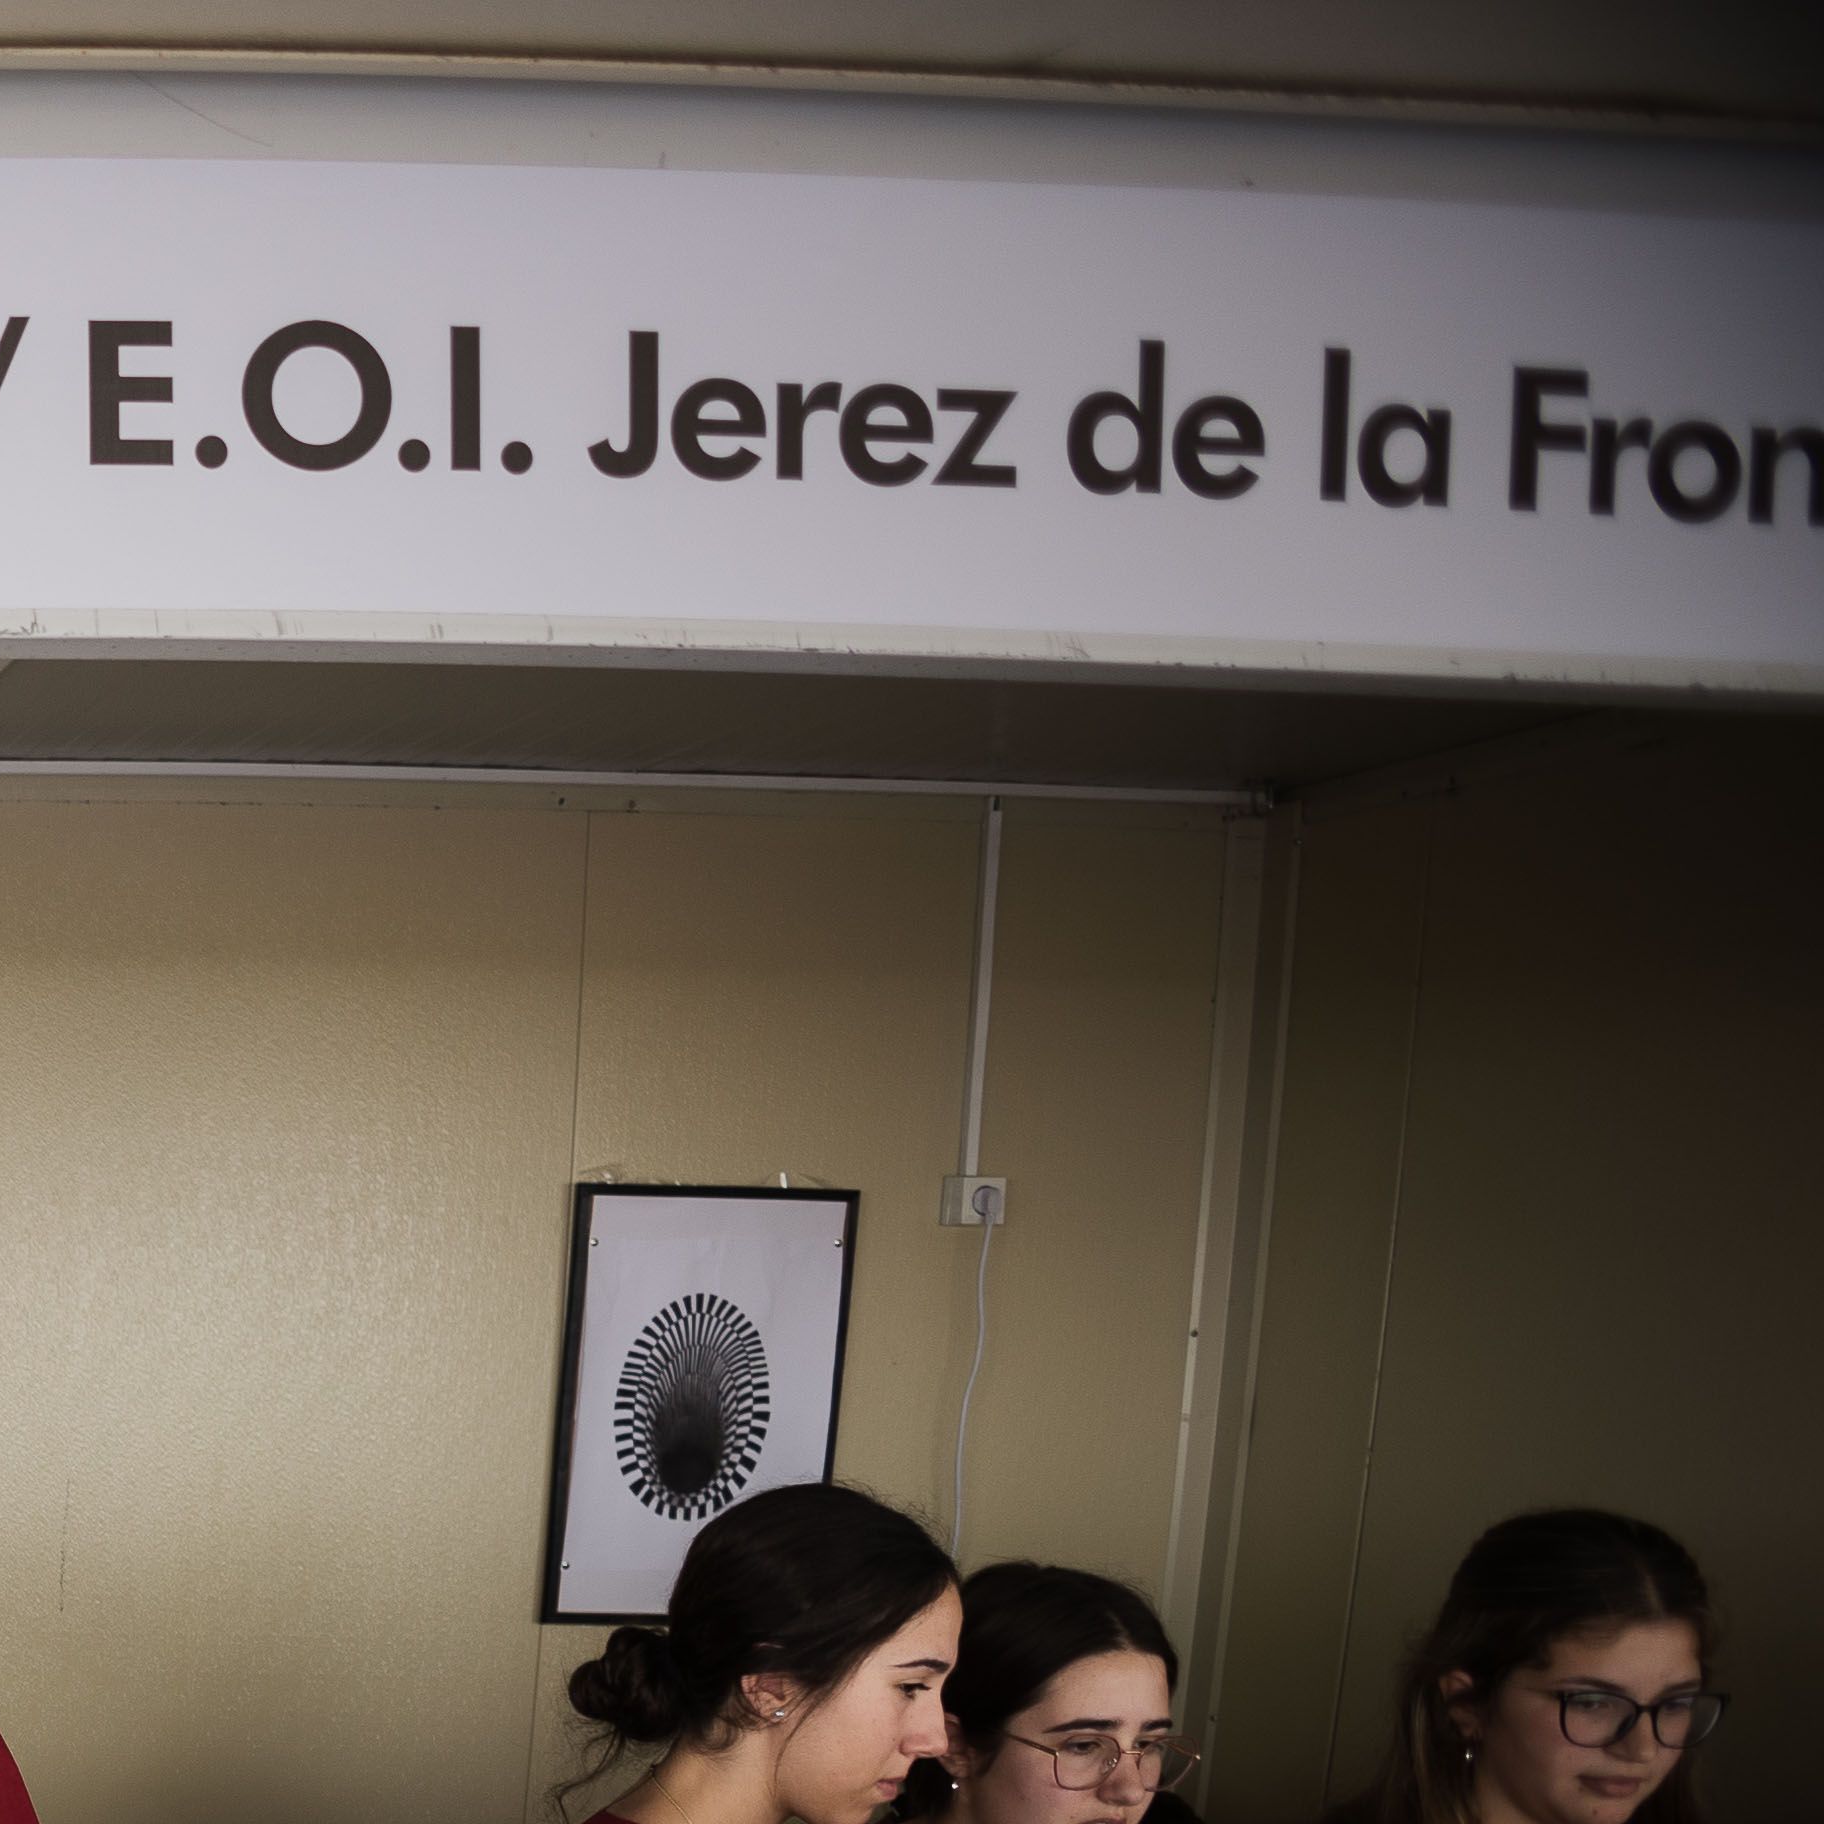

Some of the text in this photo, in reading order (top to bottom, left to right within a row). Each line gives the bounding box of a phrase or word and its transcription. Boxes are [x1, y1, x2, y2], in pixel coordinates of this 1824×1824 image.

[89, 320, 532, 474] E.O.I.
[588, 331, 1017, 488] Jerez
[1067, 339, 1265, 500] de
[1320, 345, 1453, 509] la
